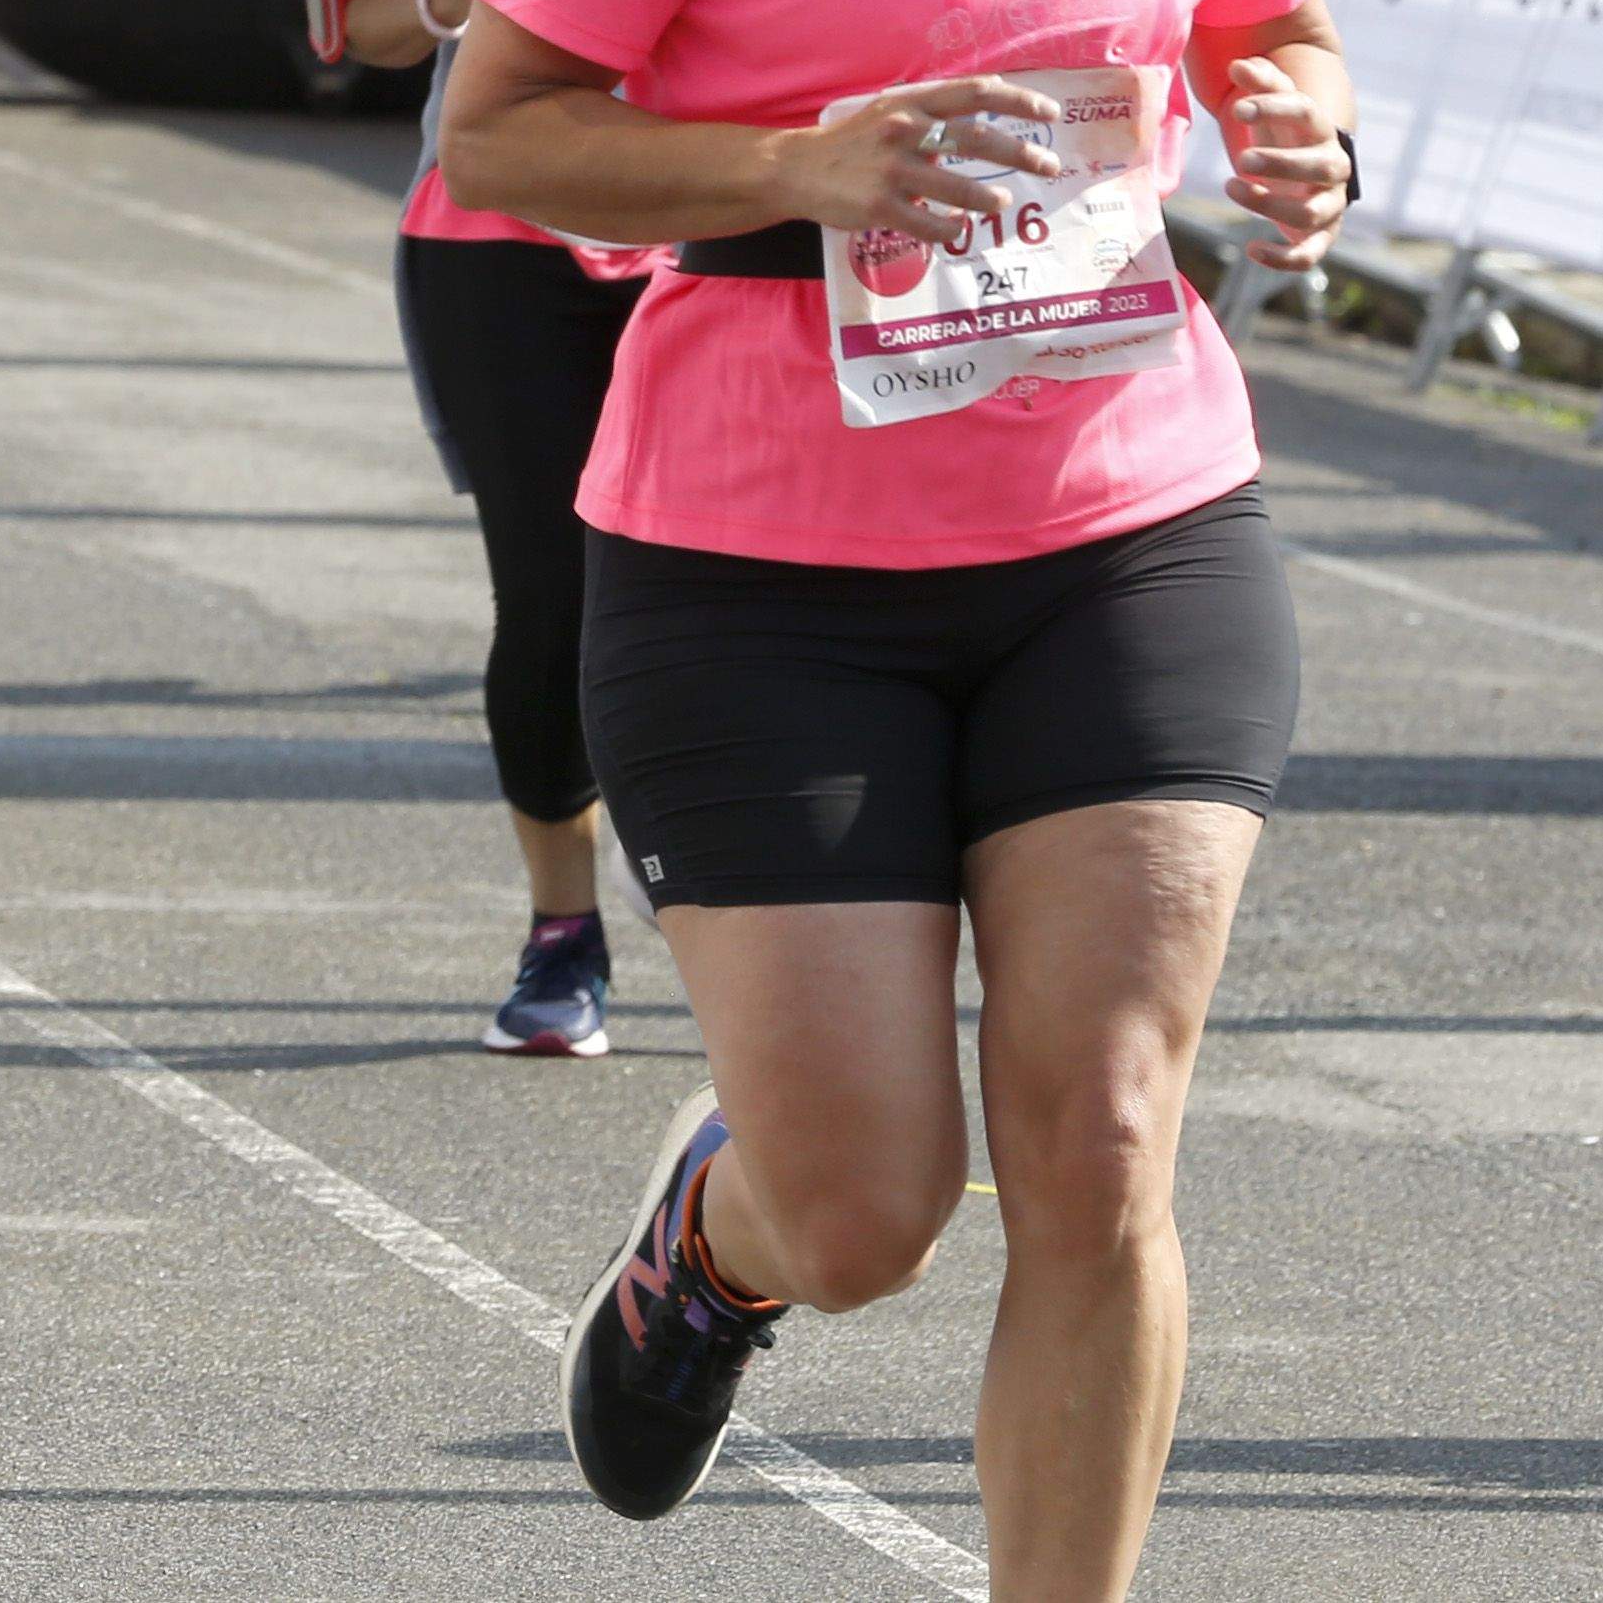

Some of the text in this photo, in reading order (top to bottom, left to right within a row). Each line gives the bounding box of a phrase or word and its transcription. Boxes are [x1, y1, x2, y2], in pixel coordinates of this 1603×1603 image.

[1063, 104, 1131, 124] SUMA
[977, 256, 1029, 297] 247
[878, 293, 1149, 348] CARRERA DE LA MUJER 2023
[872, 360, 976, 398] OYSHO
